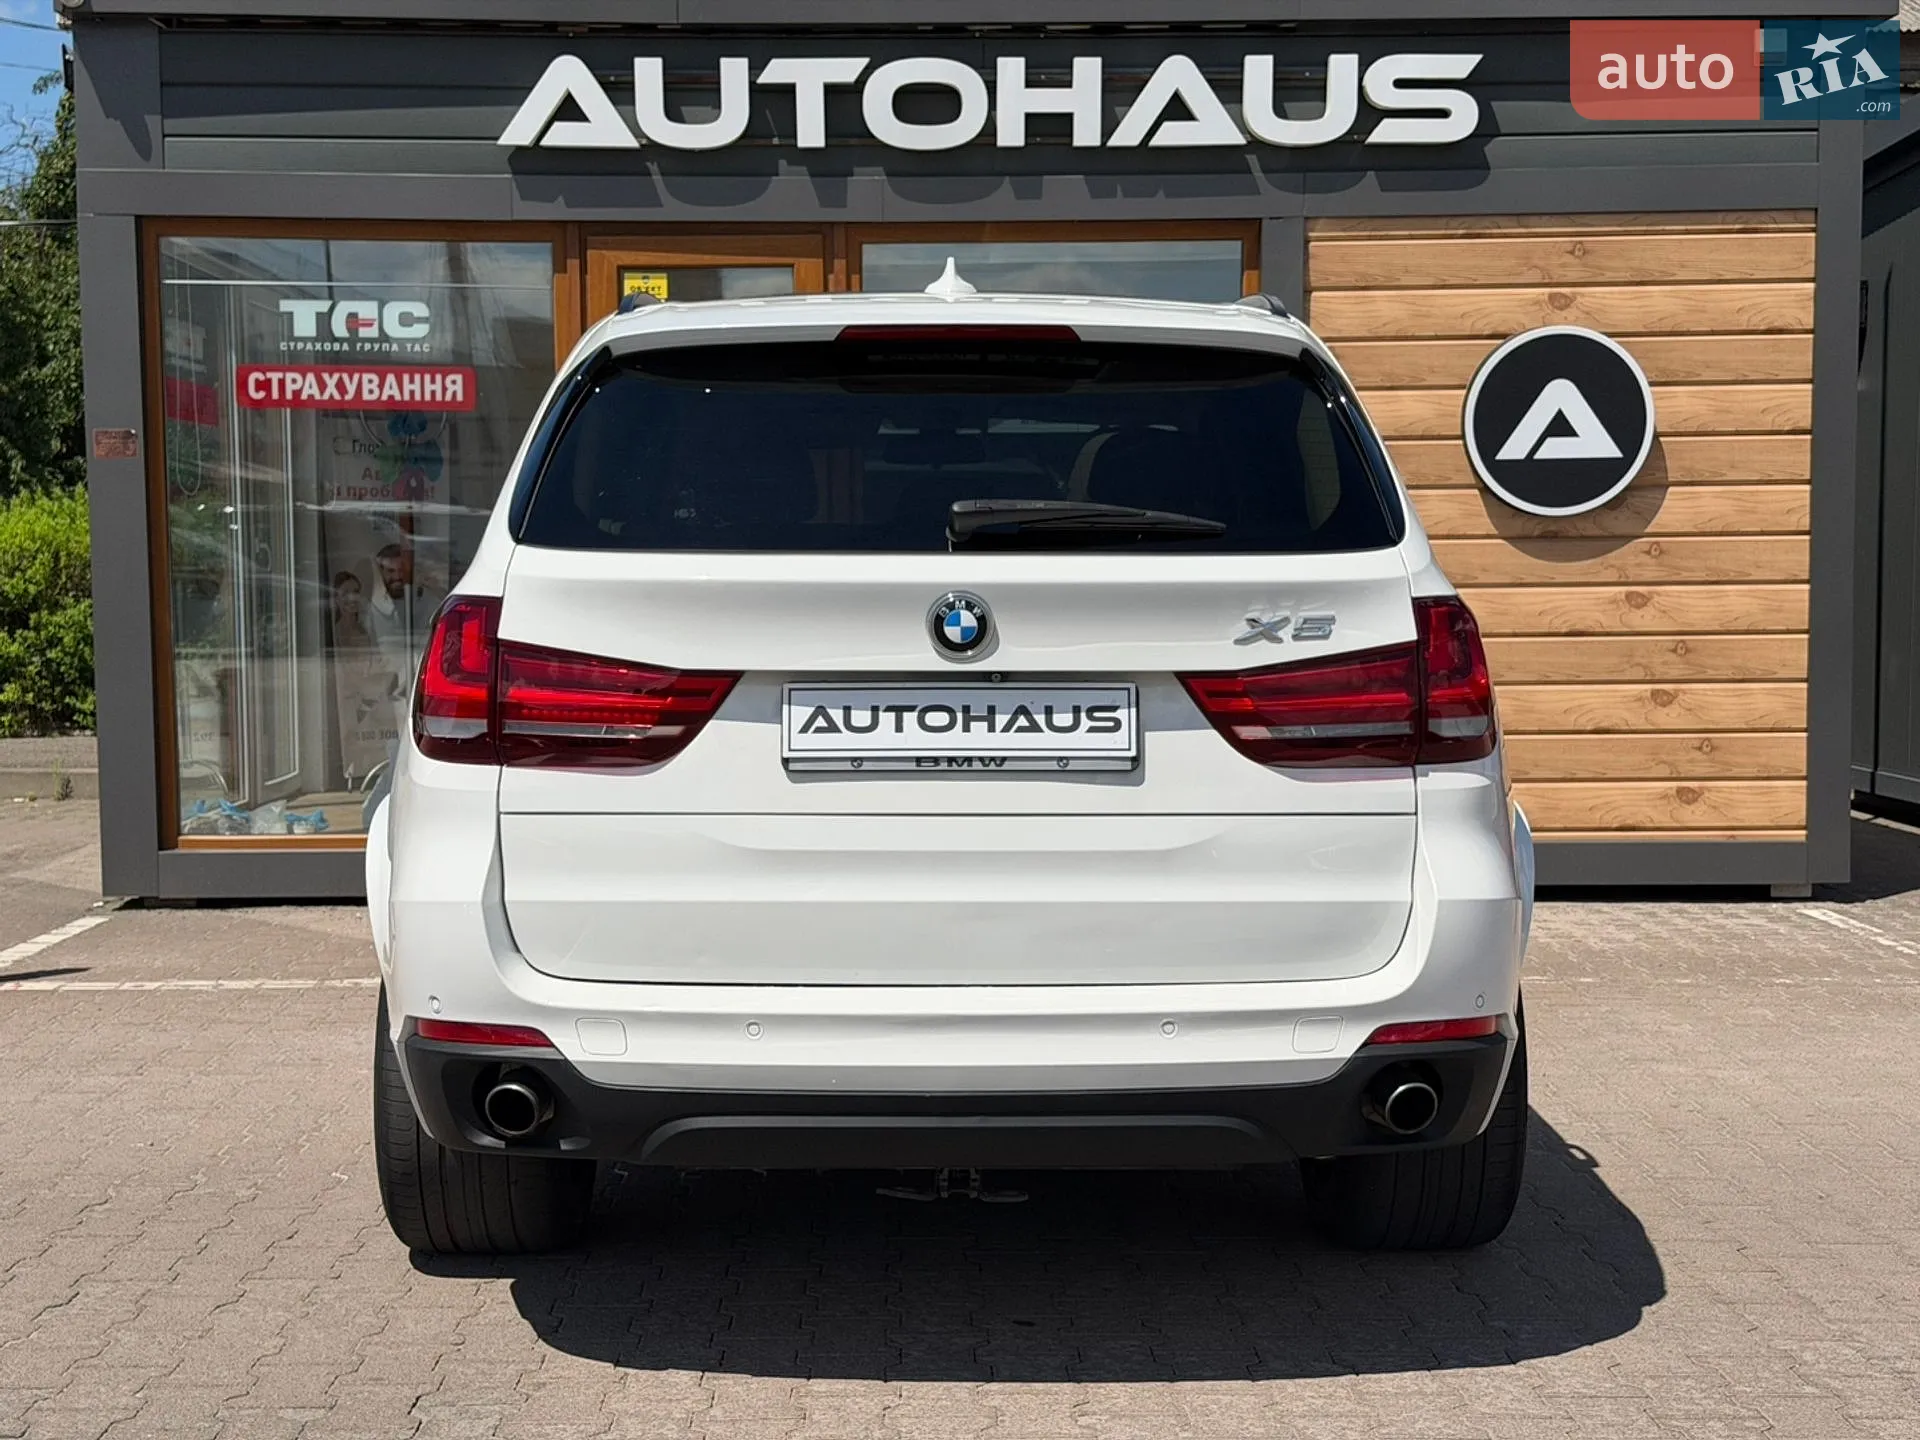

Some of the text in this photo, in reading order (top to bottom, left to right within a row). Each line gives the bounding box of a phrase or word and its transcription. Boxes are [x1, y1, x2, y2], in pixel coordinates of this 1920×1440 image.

[497, 53, 1484, 151] AUTOHAUS
[280, 341, 431, 353] СТРАХОВА ГРУПА ТАС
[247, 371, 465, 402] СТРАХУВАННЯ
[938, 599, 985, 619] BMW
[1232, 612, 1337, 646] X5
[797, 704, 1122, 734] AUTOHAUS
[915, 756, 1008, 768] BMW
